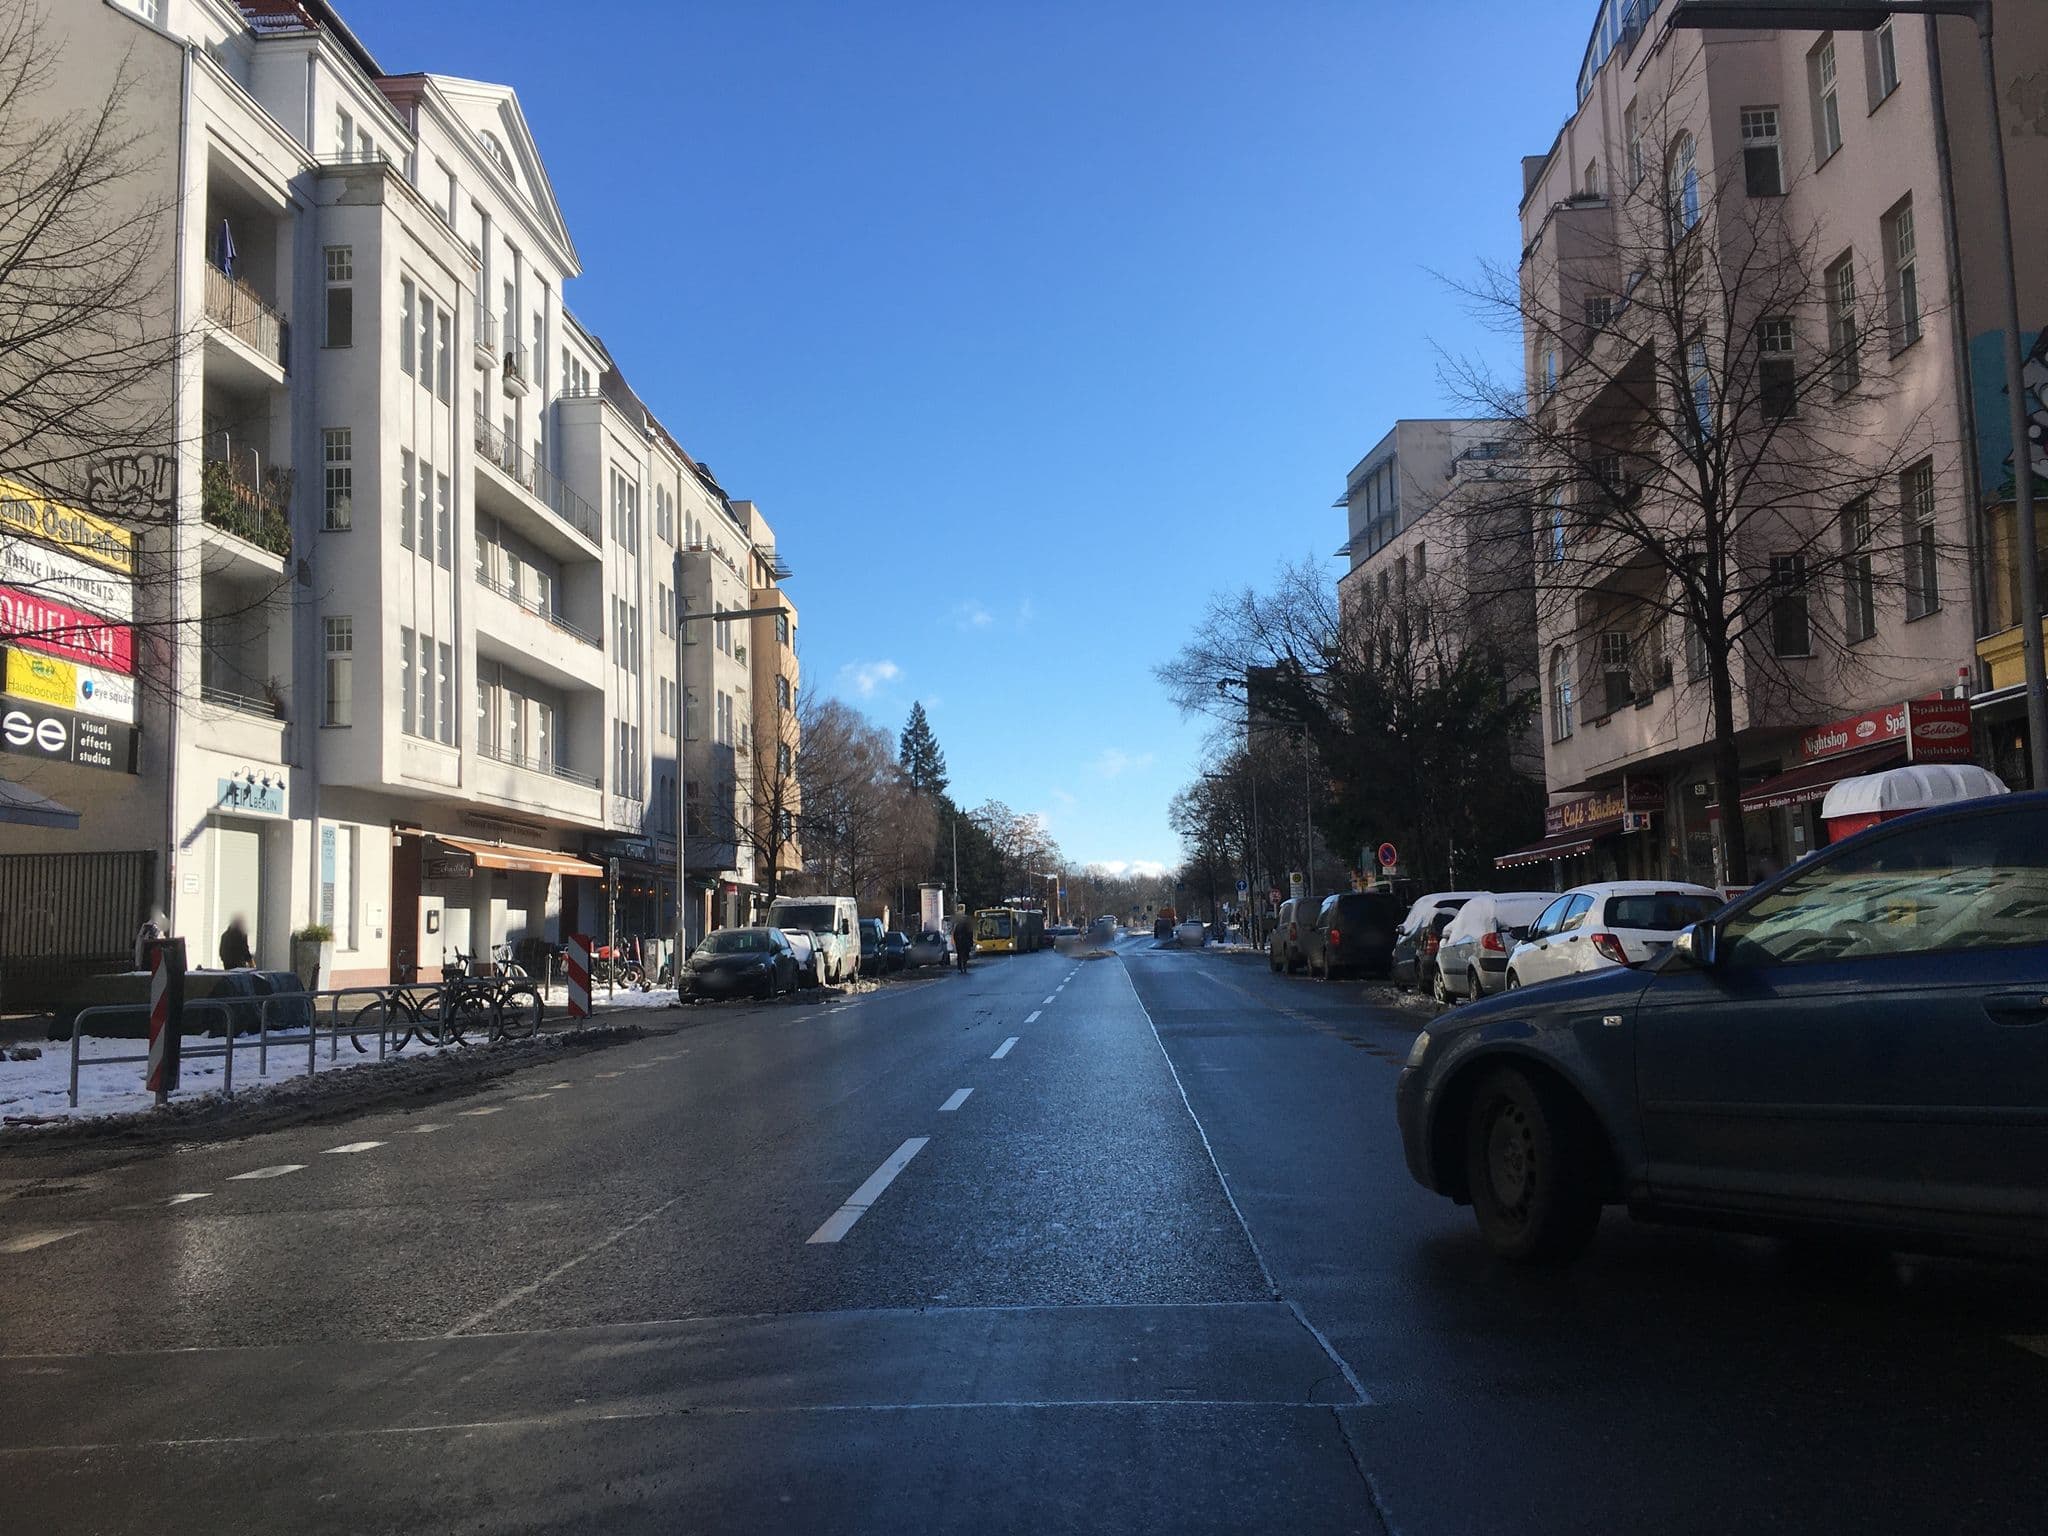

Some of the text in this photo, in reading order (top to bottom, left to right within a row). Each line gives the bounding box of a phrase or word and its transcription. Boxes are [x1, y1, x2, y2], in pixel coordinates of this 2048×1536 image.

[43, 503, 132, 566] Osthafen
[5, 549, 114, 601] NATIVE INSTRUMENTS
[95, 688, 108, 701] eye
[81, 721, 108, 736] visual
[80, 735, 112, 752] effects
[1804, 731, 1848, 756] Nightshop
[79, 751, 111, 766] studios
[254, 797, 277, 811] BERLIN
[1563, 803, 1584, 829] Café
